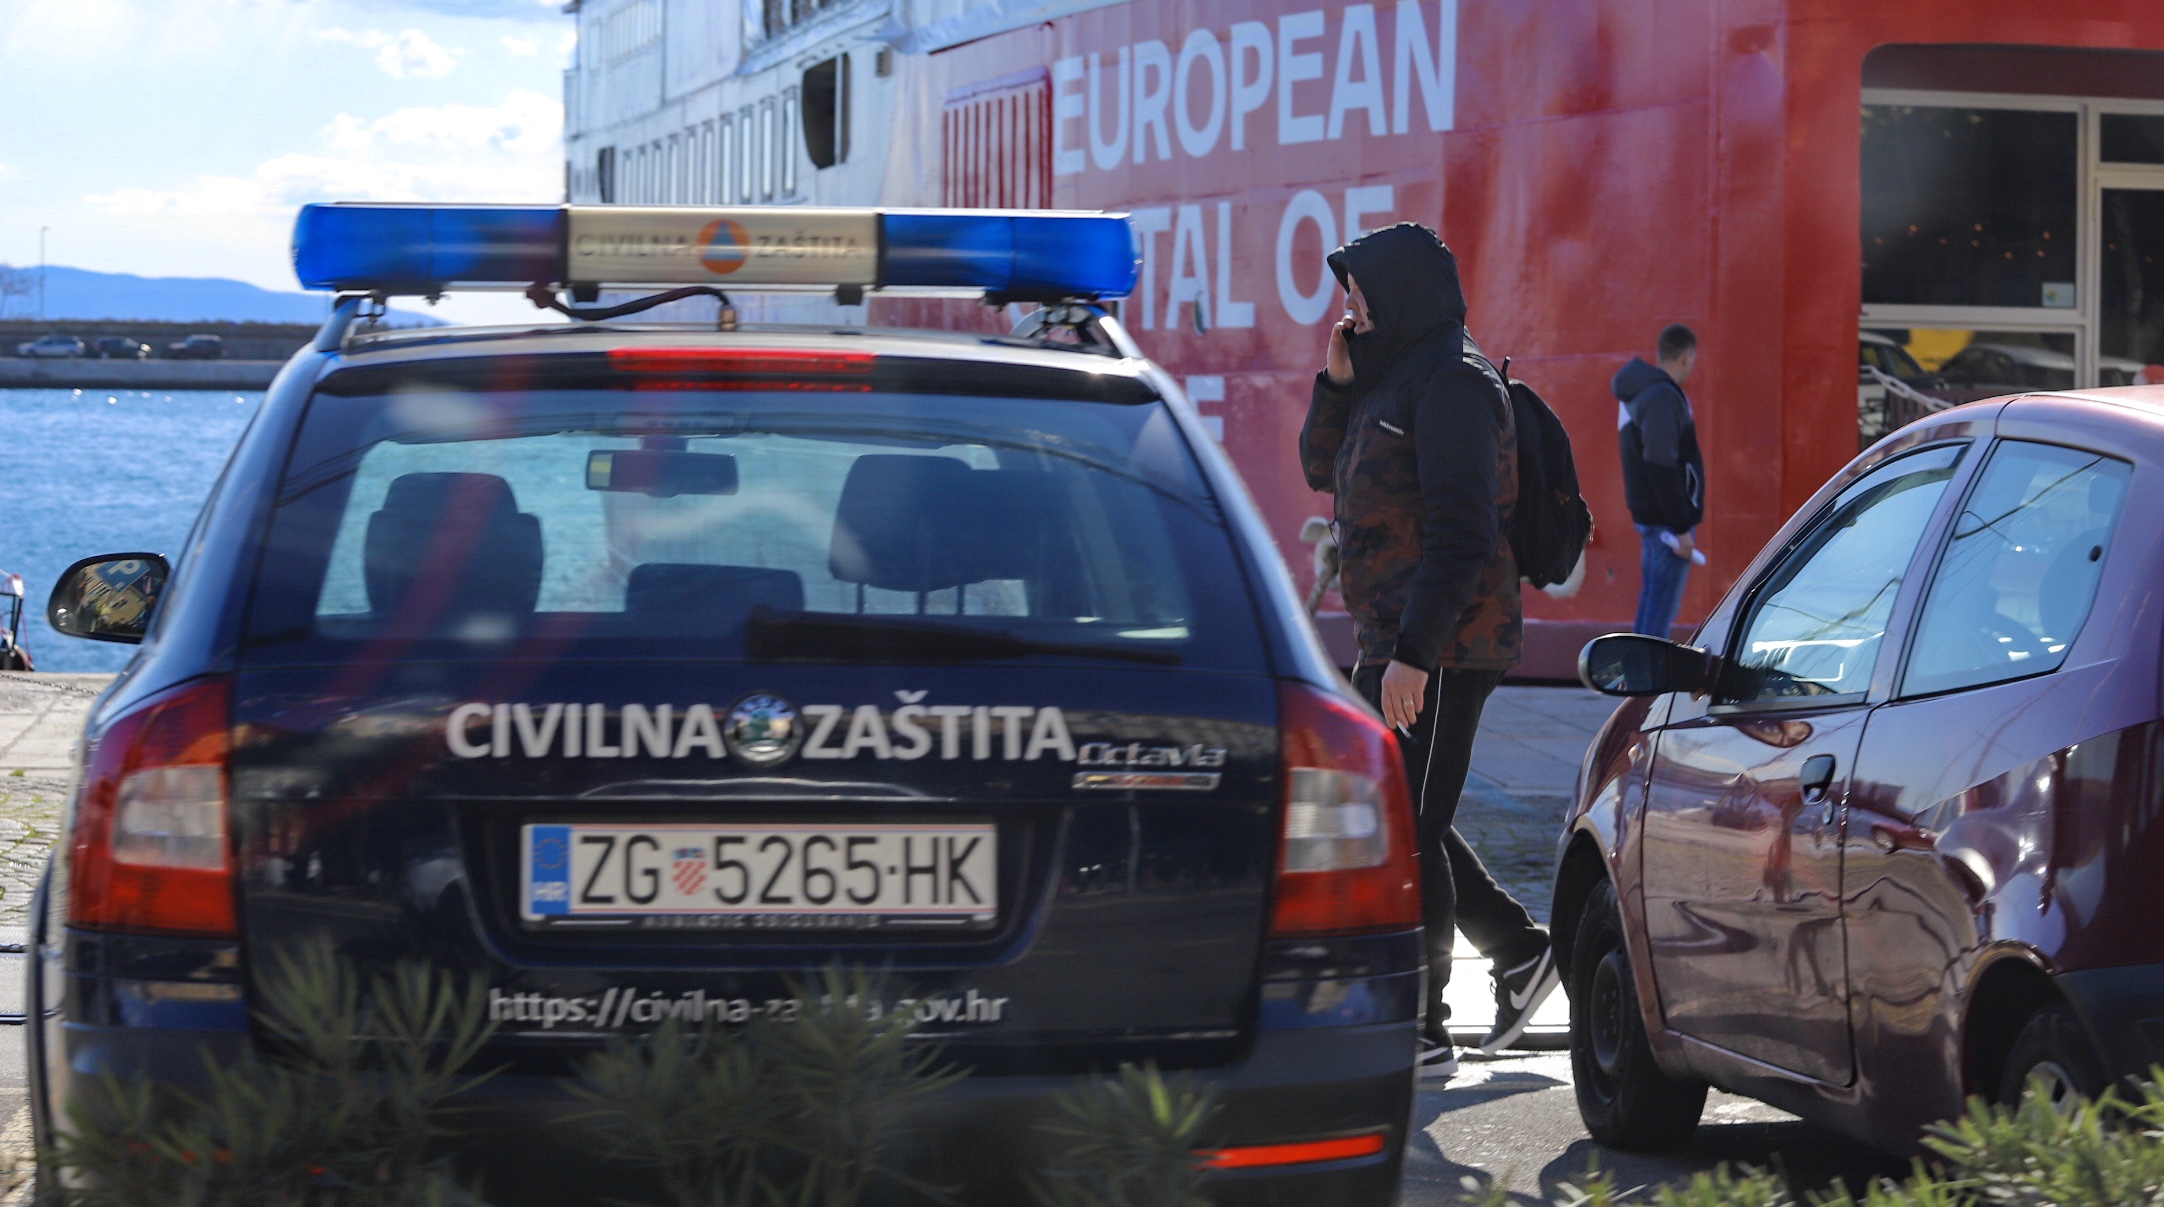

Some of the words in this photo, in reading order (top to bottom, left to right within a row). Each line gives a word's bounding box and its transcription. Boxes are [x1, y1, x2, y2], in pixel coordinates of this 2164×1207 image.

[1053, 0, 1457, 176] EUROPEAN
[576, 233, 693, 257] CIVILNA
[446, 702, 727, 759] CIVILNA
[801, 690, 1077, 760] ZAŠTITA
[1078, 742, 1228, 767] Octavia
[531, 881, 566, 901] HR
[579, 835, 660, 905] ZG
